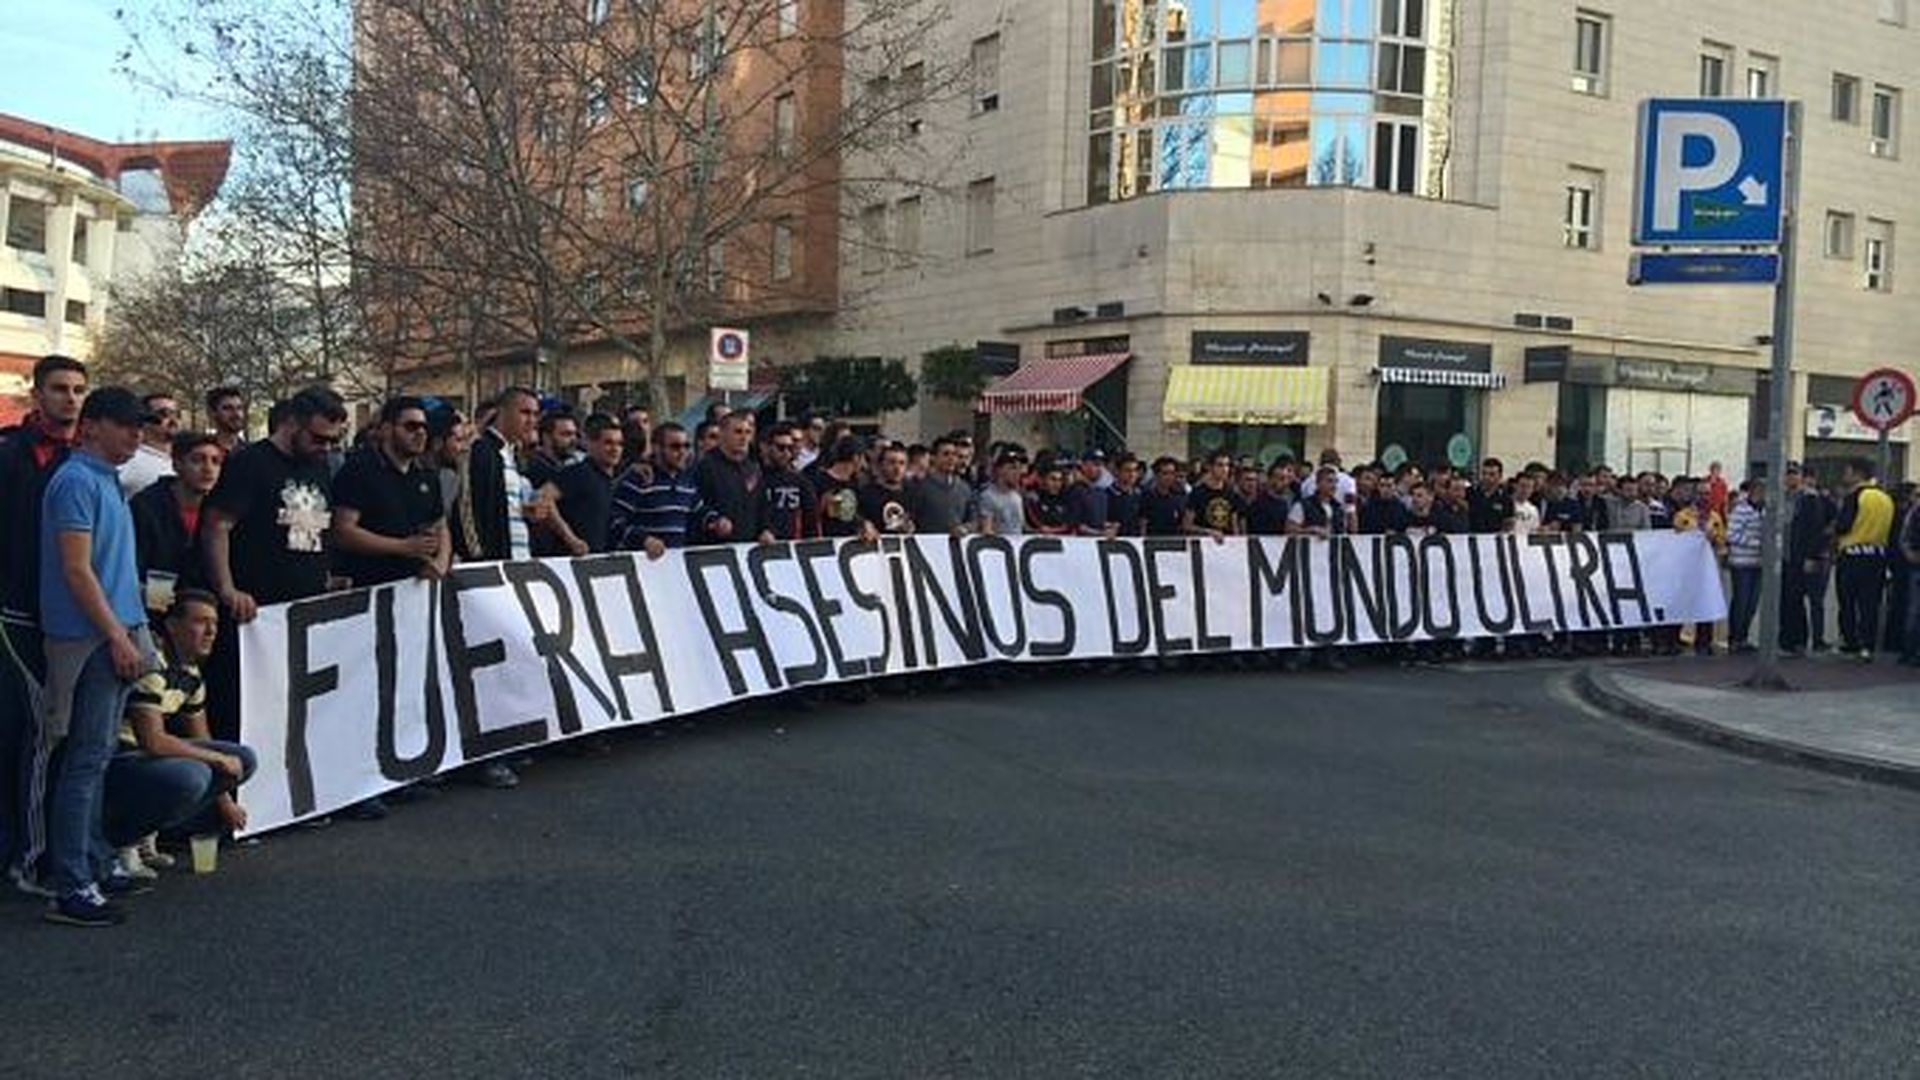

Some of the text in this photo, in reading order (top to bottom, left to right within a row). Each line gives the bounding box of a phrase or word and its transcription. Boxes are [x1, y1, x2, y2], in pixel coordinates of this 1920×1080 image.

[1652, 111, 1742, 231] P
[286, 554, 675, 817] FUERA
[1096, 538, 1232, 656] DEL
[1248, 534, 1461, 647] MUNDO
[1468, 532, 1665, 634] ULTRA.
